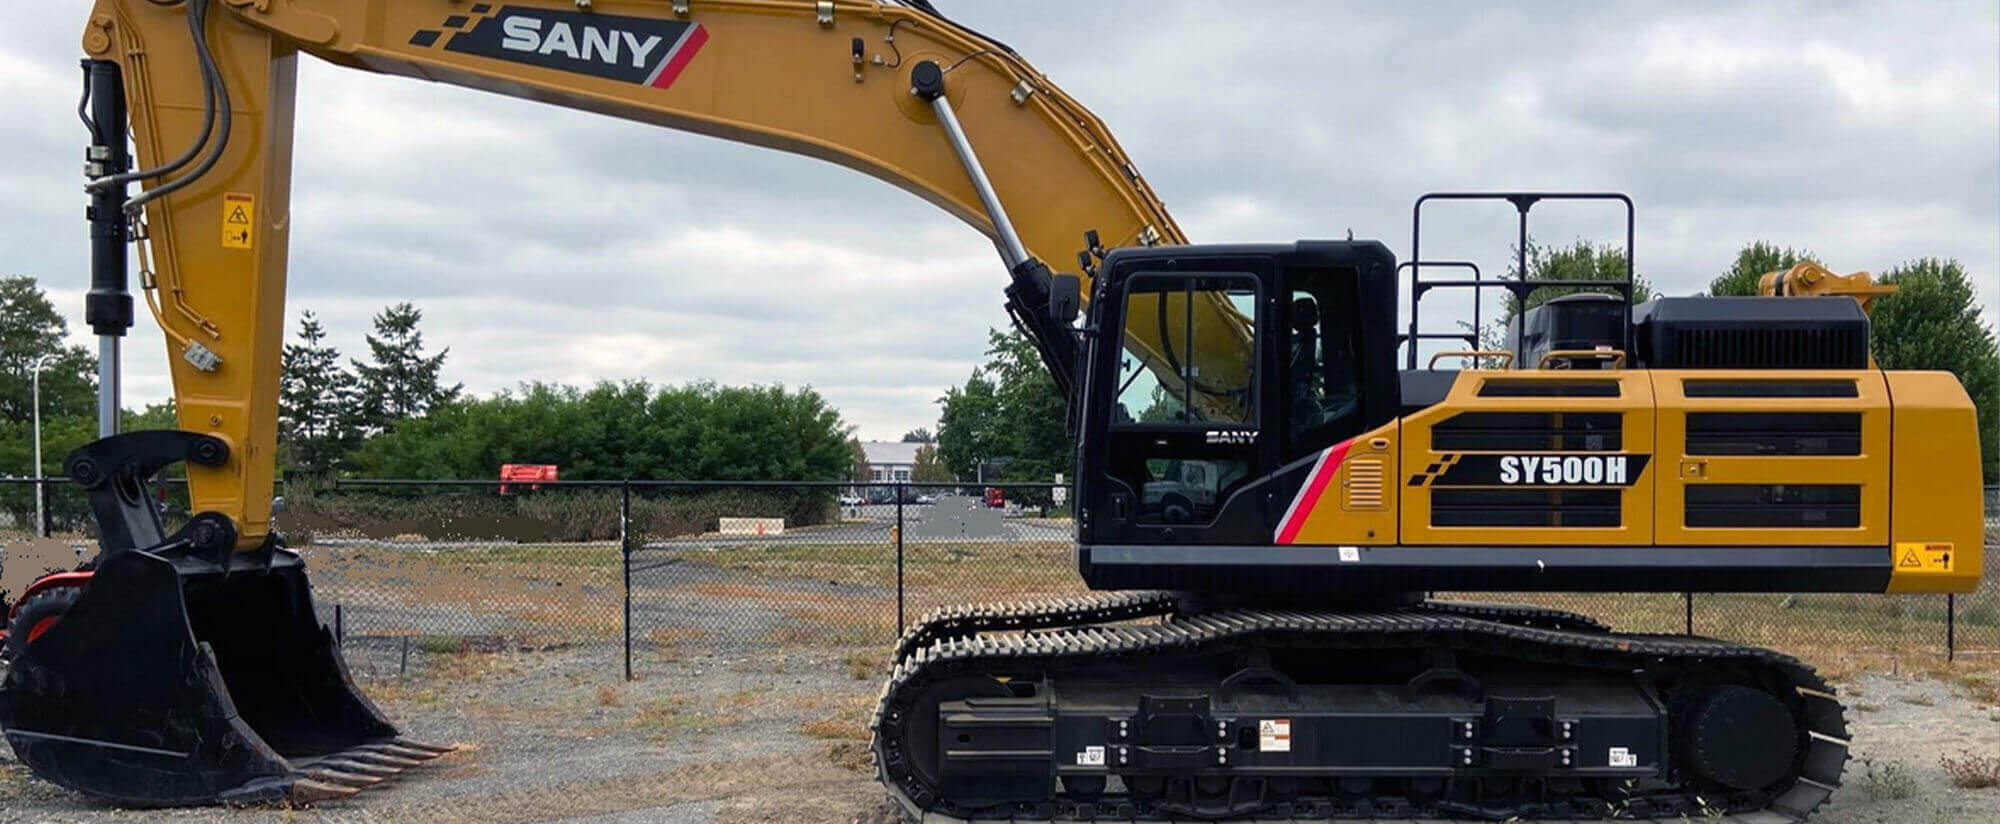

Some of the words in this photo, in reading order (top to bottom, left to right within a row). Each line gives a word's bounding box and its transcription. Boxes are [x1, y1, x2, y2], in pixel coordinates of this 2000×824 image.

[502, 15, 663, 69] SANY
[1206, 430, 1259, 444] SANY
[1500, 456, 1628, 484] SY500H
